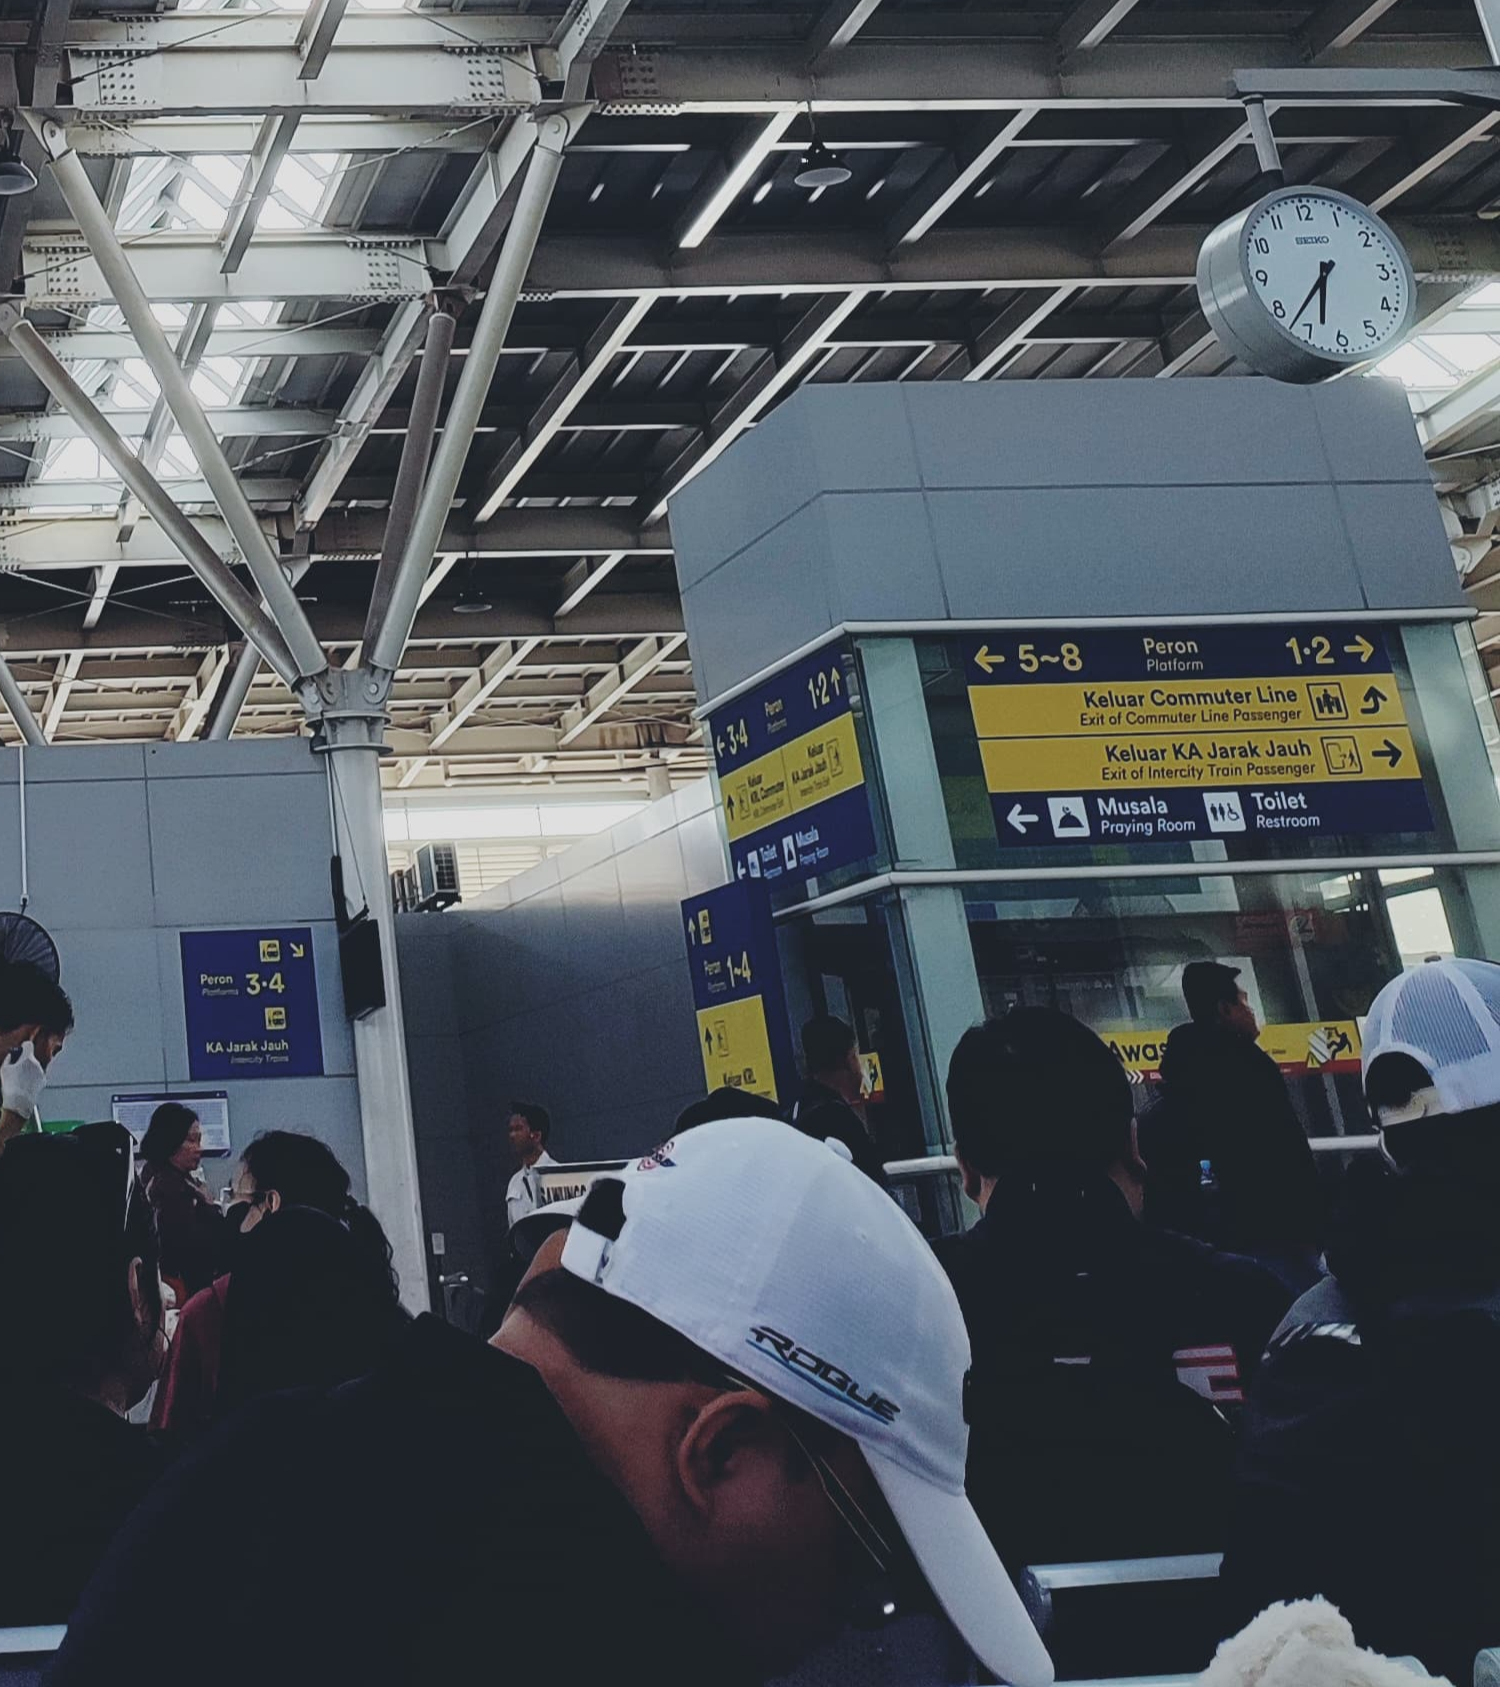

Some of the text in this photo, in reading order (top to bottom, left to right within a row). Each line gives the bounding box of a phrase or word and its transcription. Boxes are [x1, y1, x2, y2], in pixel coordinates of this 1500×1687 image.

[1296, 205, 1314, 221] 12
[1332, 211, 1340, 228] 1
[1271, 214, 1283, 231] 11
[1254, 238, 1270, 254] 10
[1295, 236, 1330, 245] SEIKO
[1357, 231, 1372, 248] 2
[1255, 270, 1268, 287] 9
[1376, 264, 1390, 281] 3
[1272, 300, 1286, 319] 8
[1380, 296, 1392, 313] 4
[1302, 323, 1313, 339] 7
[1363, 320, 1376, 338] 5
[1336, 330, 1349, 347] 6
[1143, 638, 1198, 654] Peron
[1019, 642, 1082, 673] 5~8
[1147, 658, 1204, 672] Platform
[1083, 685, 1298, 708] Keluar Commuter Line
[1080, 708, 1302, 726] Exit of Commuter Line Passenger
[1105, 738, 1313, 763] Keluar KA Jarak Jauh
[1102, 762, 1316, 781] Exit of Intercity Train Passenger
[1097, 796, 1168, 817] Musala
[1250, 791, 1308, 812] Toilet
[1101, 818, 1196, 836] Praying Room
[1256, 815, 1321, 829] Restroom
[200, 973, 234, 985] Peron
[206, 1039, 289, 1054] KA Jarak Jauh
[750, 1326, 901, 1422] ROGUE
